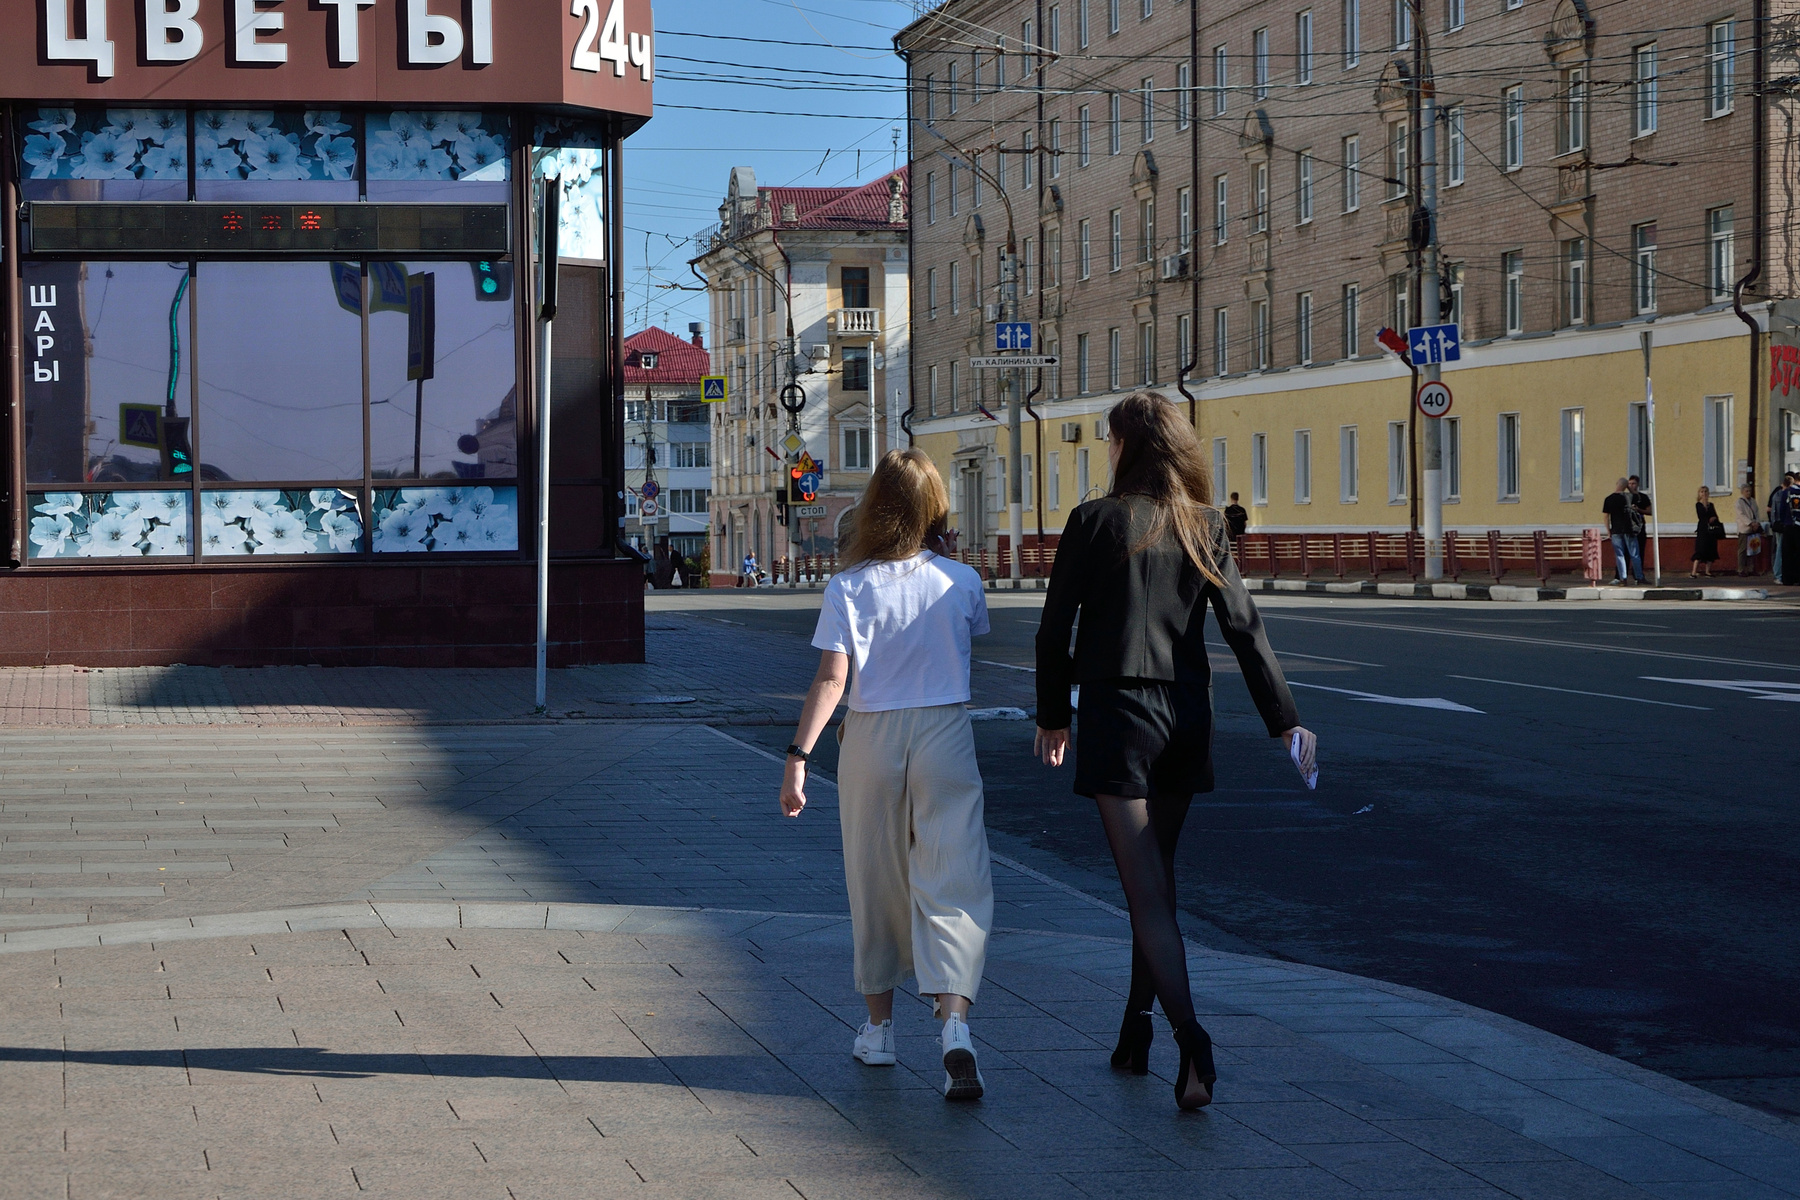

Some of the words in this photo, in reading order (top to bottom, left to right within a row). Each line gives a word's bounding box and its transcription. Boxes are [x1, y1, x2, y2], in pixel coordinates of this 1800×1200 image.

[47, 0, 493, 77] ЦВЕТЫ
[570, 0, 651, 81] 24ч
[30, 285, 59, 382] ШАРЫ
[985, 358, 1032, 366] КАЛИНИНА
[1423, 392, 1445, 407] 40
[801, 506, 824, 515] СТОП
